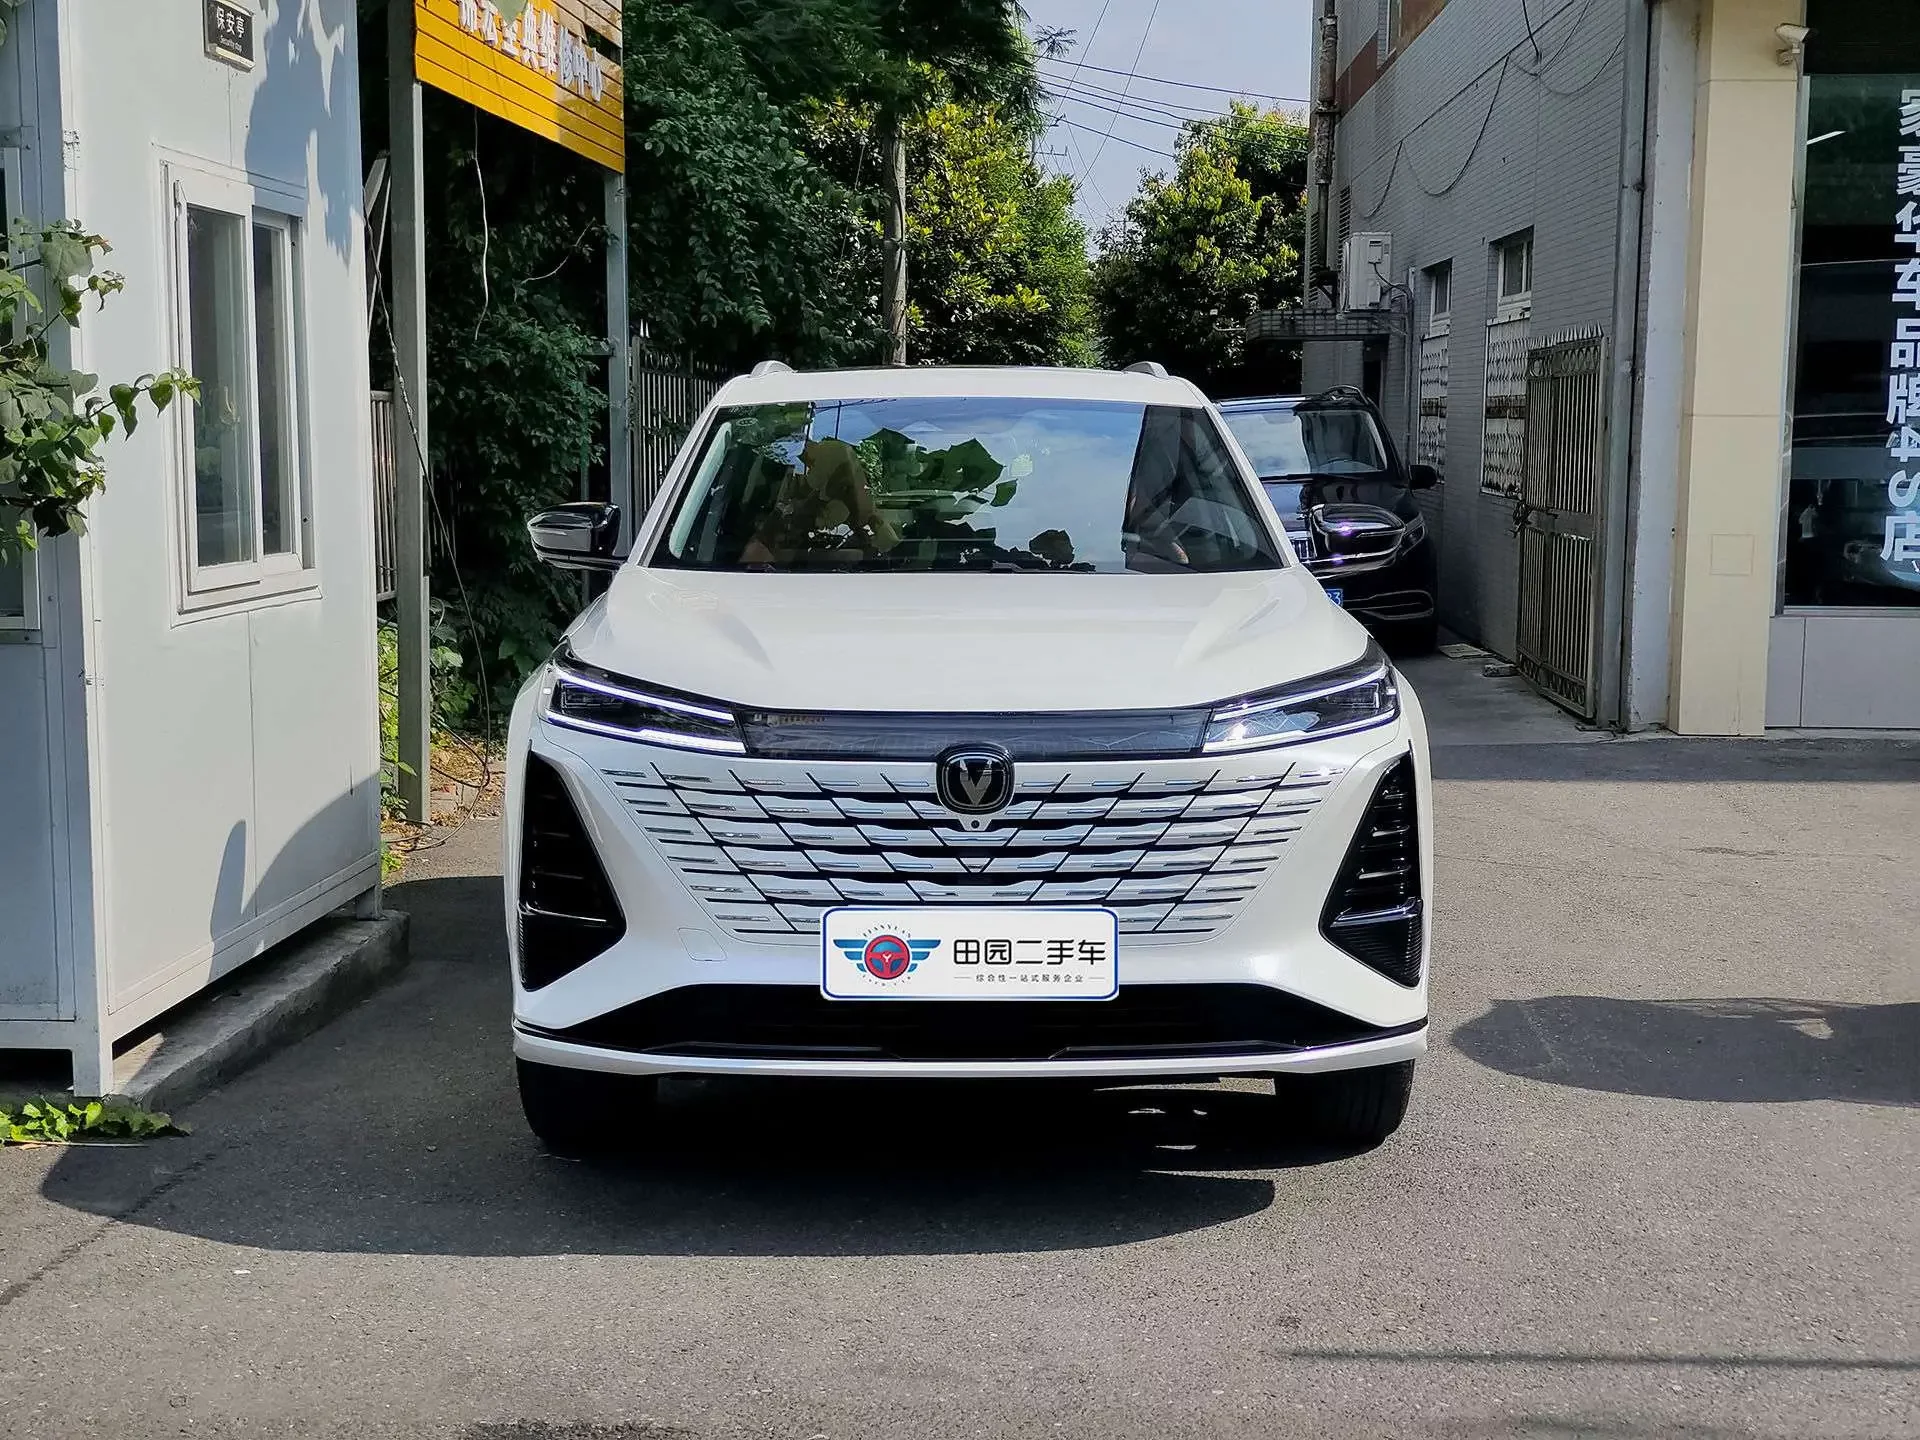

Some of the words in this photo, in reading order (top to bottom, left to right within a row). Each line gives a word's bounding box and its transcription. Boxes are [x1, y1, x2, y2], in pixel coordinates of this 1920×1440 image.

[216, 6, 245, 38] 保安亭
[953, 939, 1106, 965] 田园二手车
[976, 974, 1084, 983] 综合性一站式服务企业
